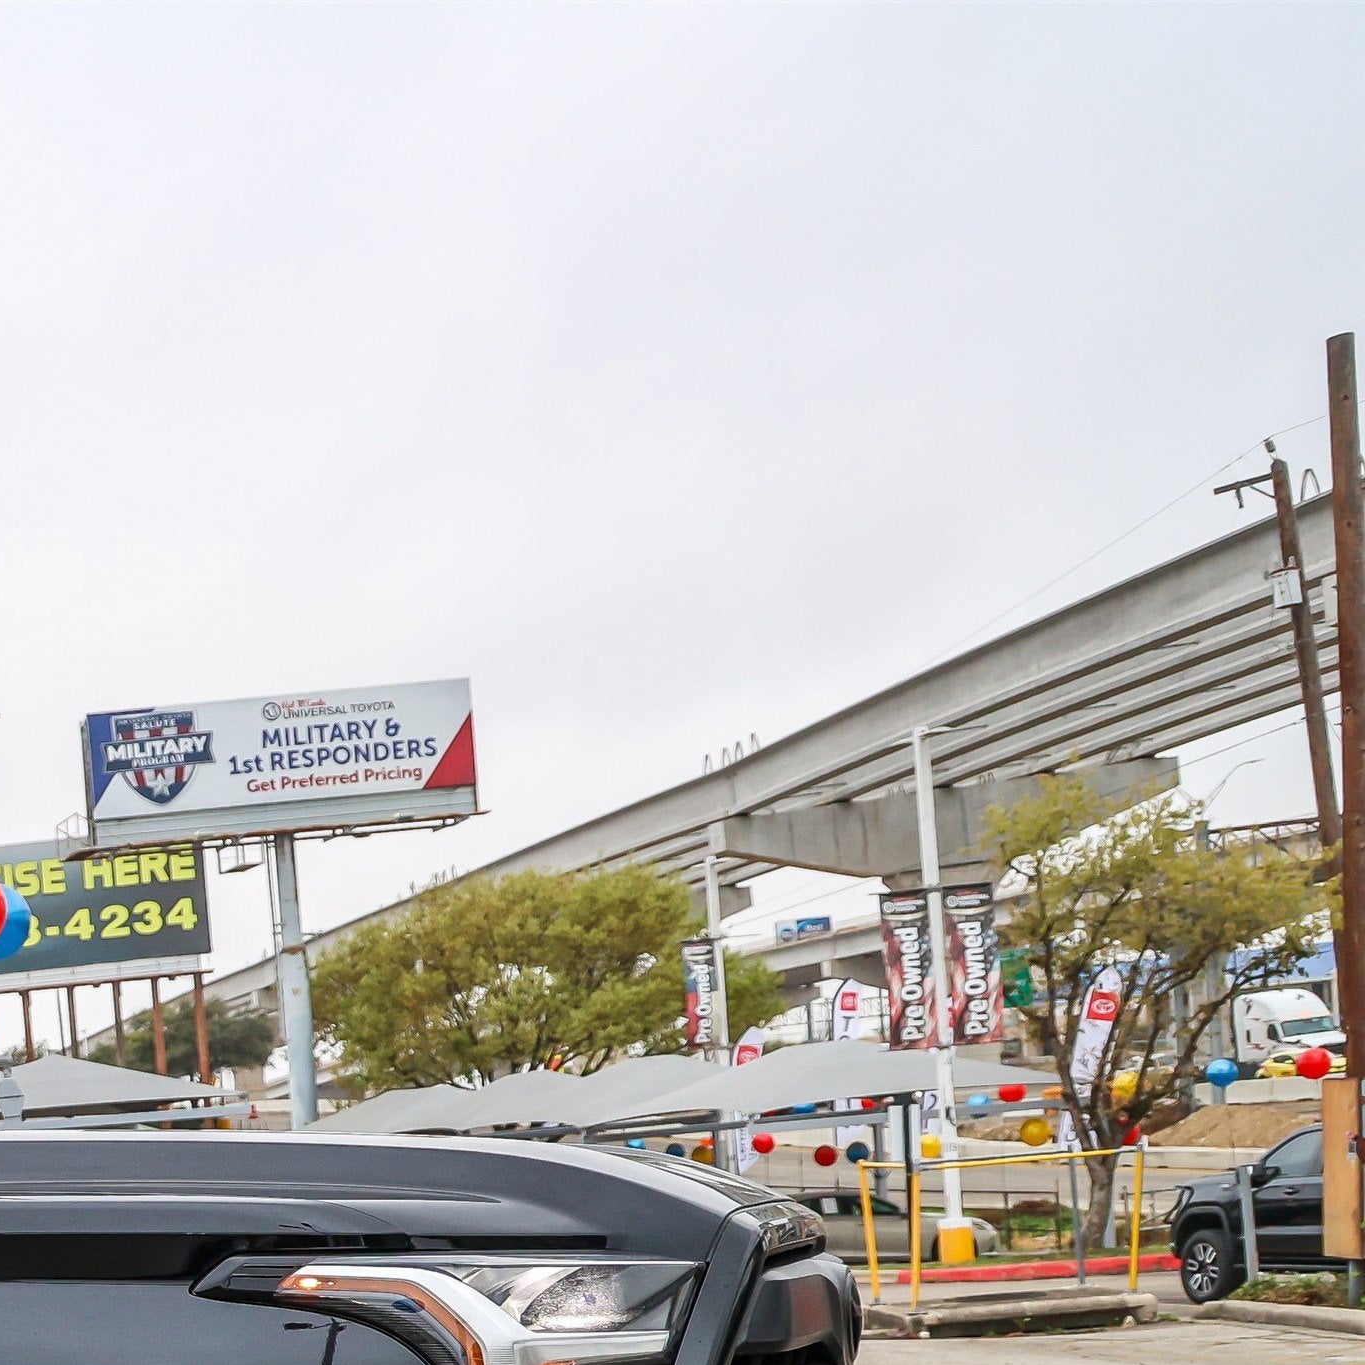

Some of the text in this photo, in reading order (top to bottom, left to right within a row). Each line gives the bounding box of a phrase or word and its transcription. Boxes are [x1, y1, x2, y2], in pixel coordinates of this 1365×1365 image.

[134, 718, 176, 729] SALUTE
[283, 701, 396, 719] UNIVERSAL TOYOTA
[106, 735, 207, 761] MILITARY
[262, 717, 400, 748] MILITARY &
[131, 754, 185, 768] PROGRAM
[229, 737, 438, 775] 1st RESPONDERS
[247, 766, 423, 793] Get Preferred Pricing
[83, 844, 196, 890] HERE
[893, 926, 923, 1001] Owned
[956, 921, 988, 996] Owned
[694, 964, 713, 1017] Owned
[694, 1018, 712, 1043] Pre
[900, 1004, 926, 1041] Pre
[964, 999, 989, 1036] Pre
